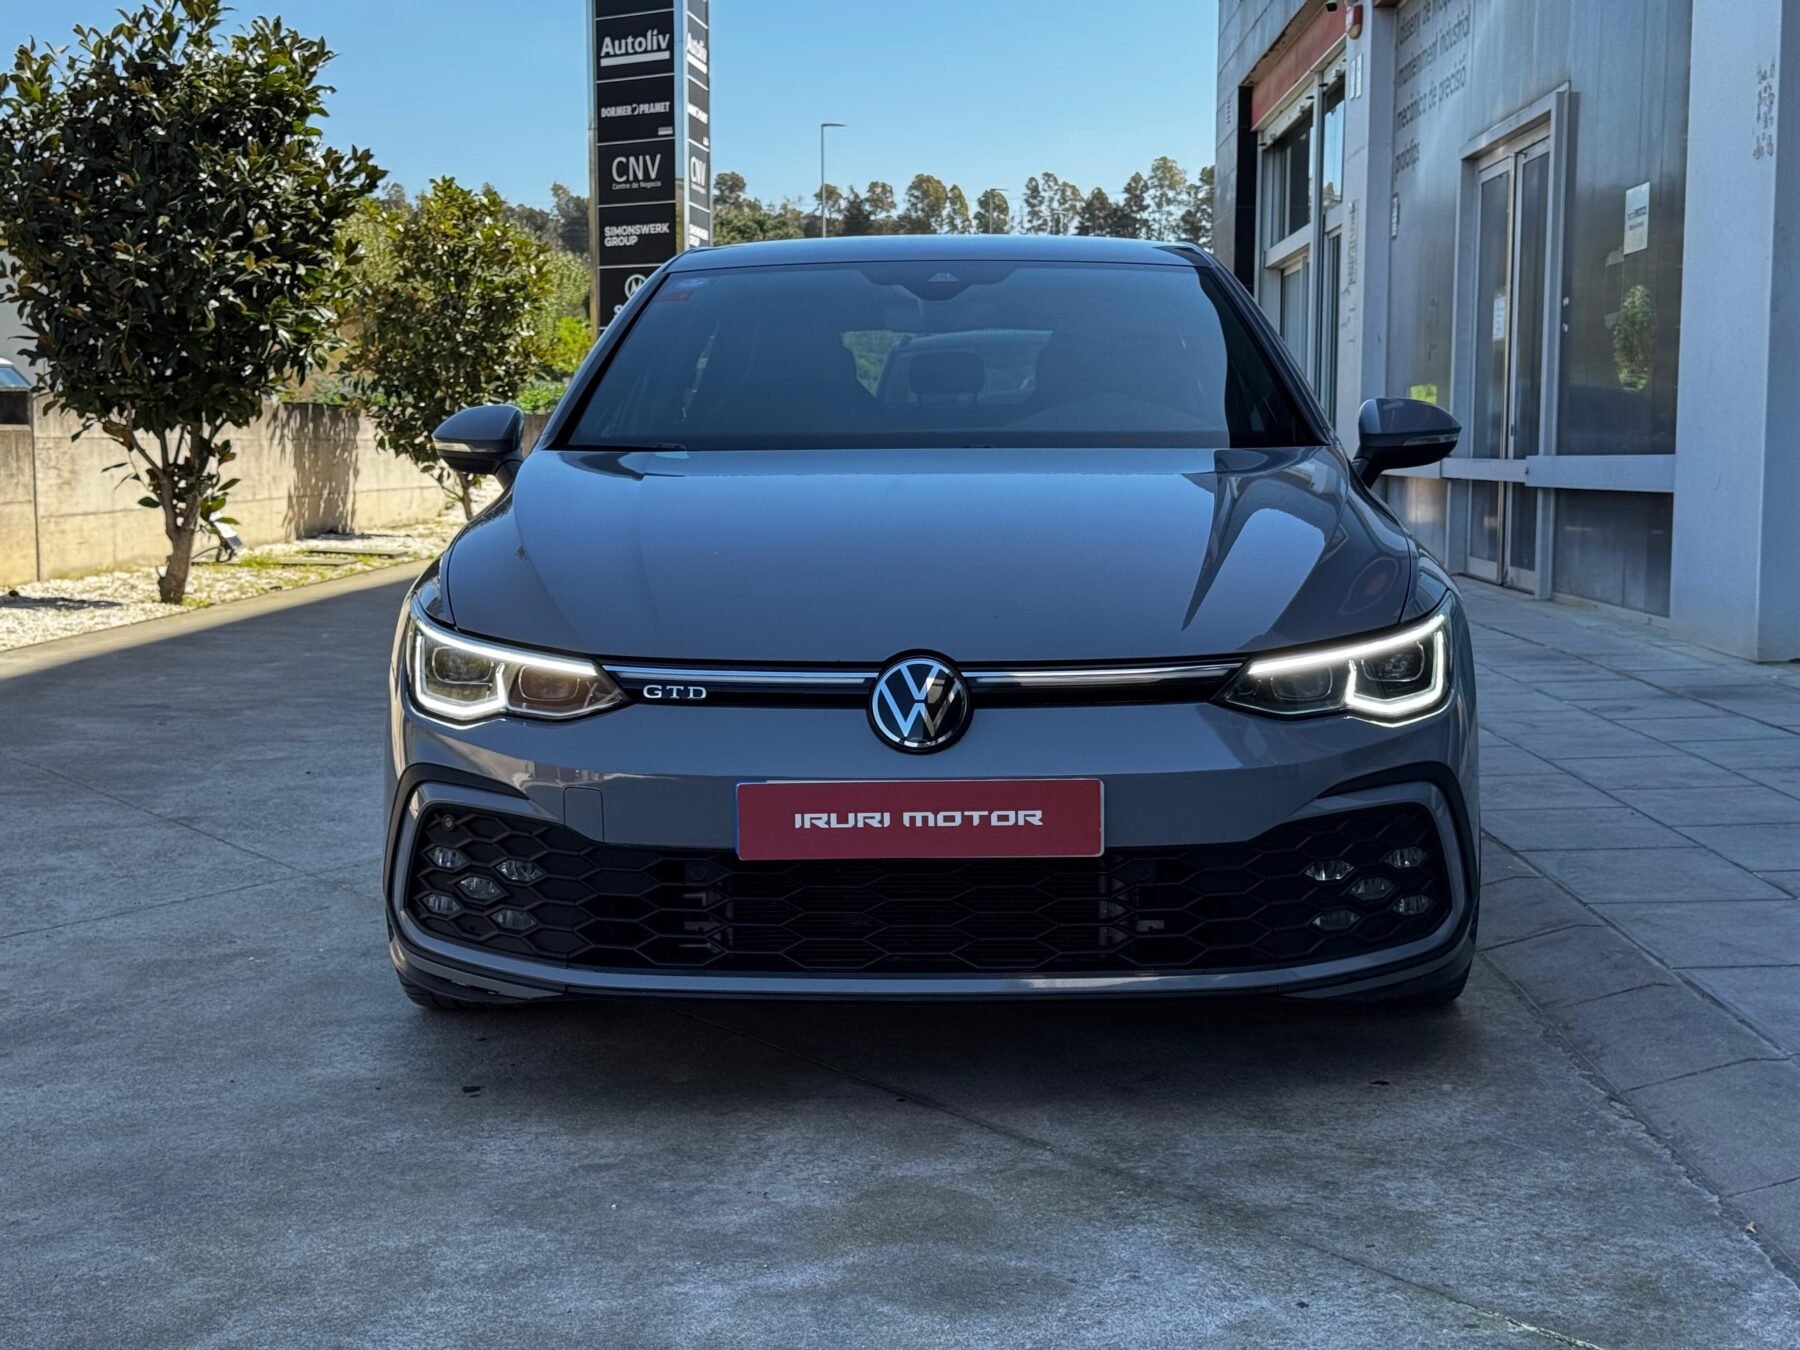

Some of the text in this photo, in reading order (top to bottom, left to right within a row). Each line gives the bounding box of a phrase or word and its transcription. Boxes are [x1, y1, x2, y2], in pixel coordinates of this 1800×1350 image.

[600, 29, 670, 57] Autoliv
[611, 154, 661, 182] CNV
[604, 223, 670, 237] SIMONSWERK
[604, 236, 638, 247] GROUP
[643, 685, 707, 699] GTD
[795, 810, 1043, 829] IRURI MOTOR
